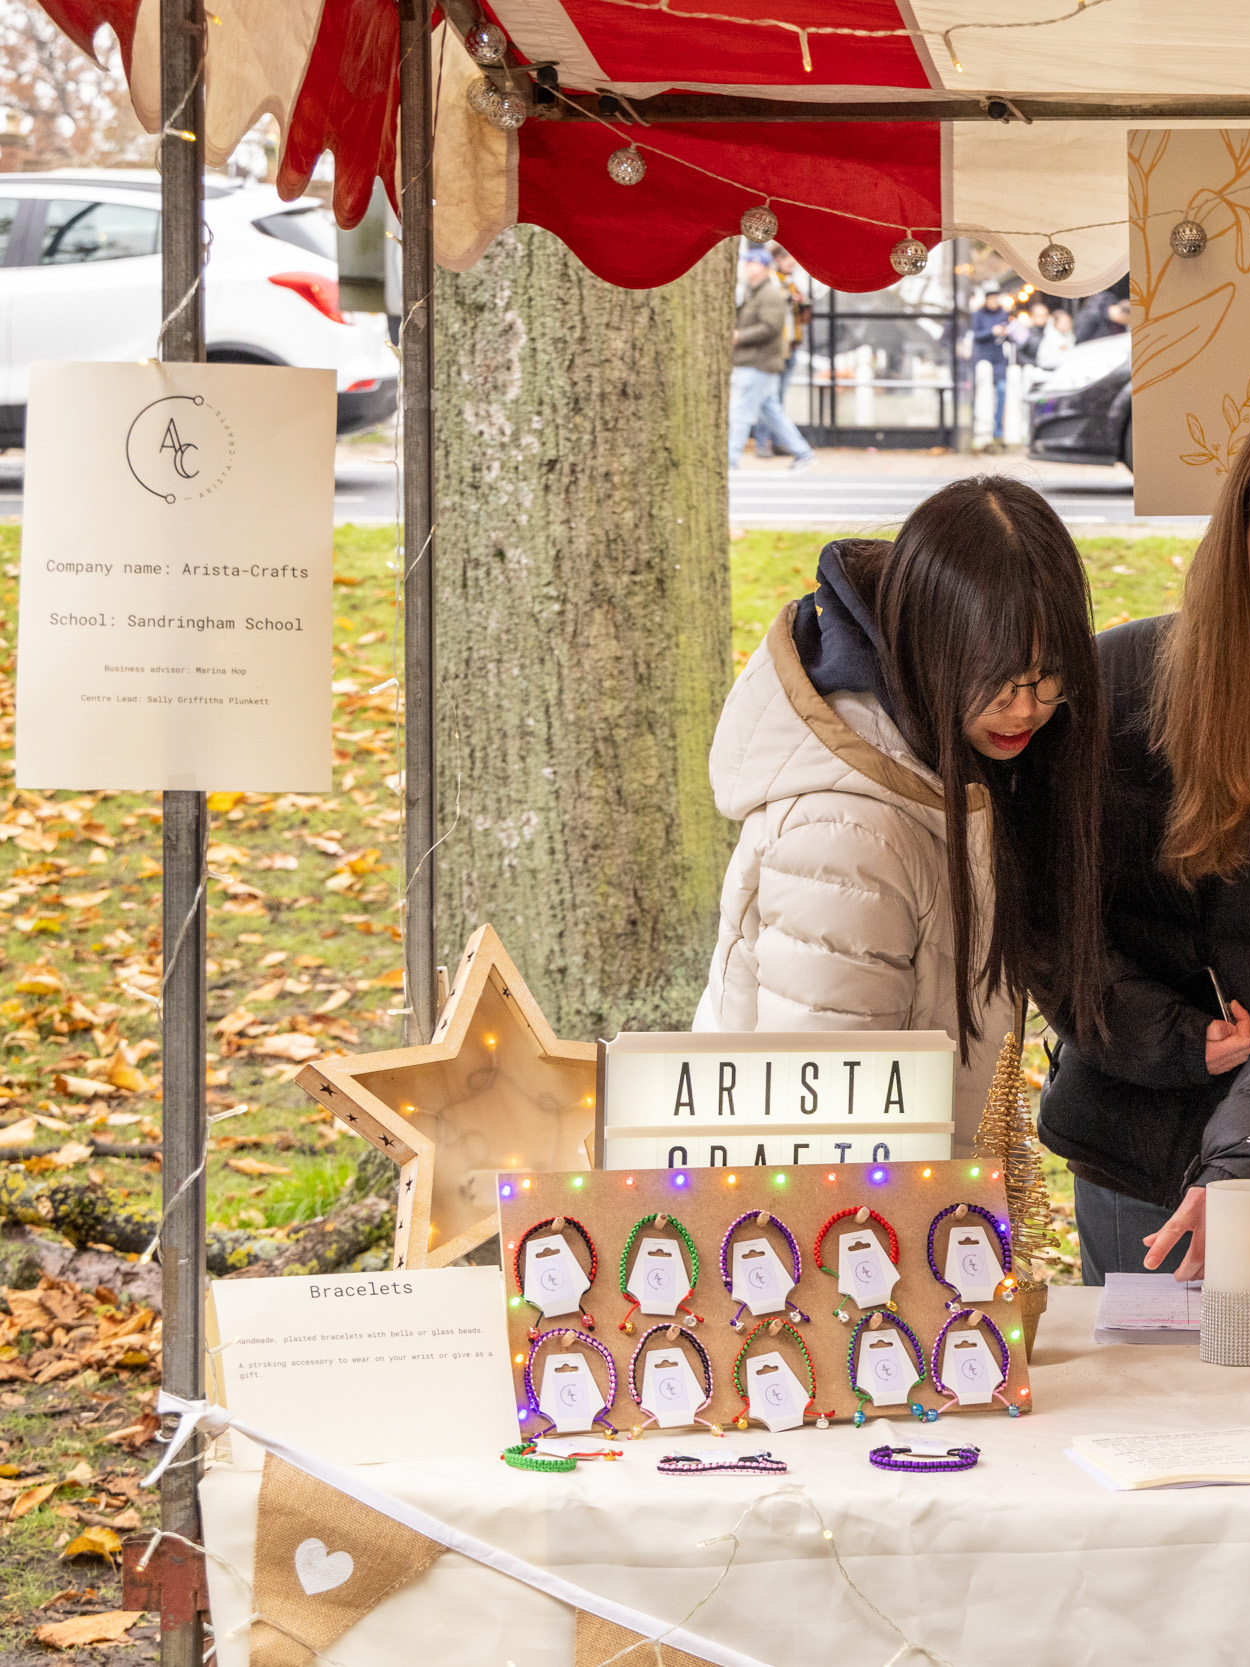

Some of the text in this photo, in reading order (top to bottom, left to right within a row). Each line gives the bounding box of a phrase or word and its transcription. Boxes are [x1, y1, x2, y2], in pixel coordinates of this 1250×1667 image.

[46, 559, 309, 579] Company name: Arista-Crafts
[49, 612, 304, 633] School: Sandringham School
[104, 664, 248, 676] Business advisor: Marina Hop
[80, 694, 269, 706] Centre Lead: Sally Griffiths Plunkett
[673, 1060, 905, 1116] ARISTA
[309, 1281, 413, 1299] Bracelets
[283, 1334, 317, 1344] plaited
[320, 1332, 364, 1341] bracelets
[367, 1331, 387, 1339] with
[390, 1329, 414, 1338] bells
[431, 1328, 455, 1337] glass
[458, 1327, 485, 1335] beads.
[248, 1360, 287, 1369] striking
[291, 1358, 334, 1367] accessory
[388, 1355, 407, 1363] your
[452, 1352, 471, 1360] give
